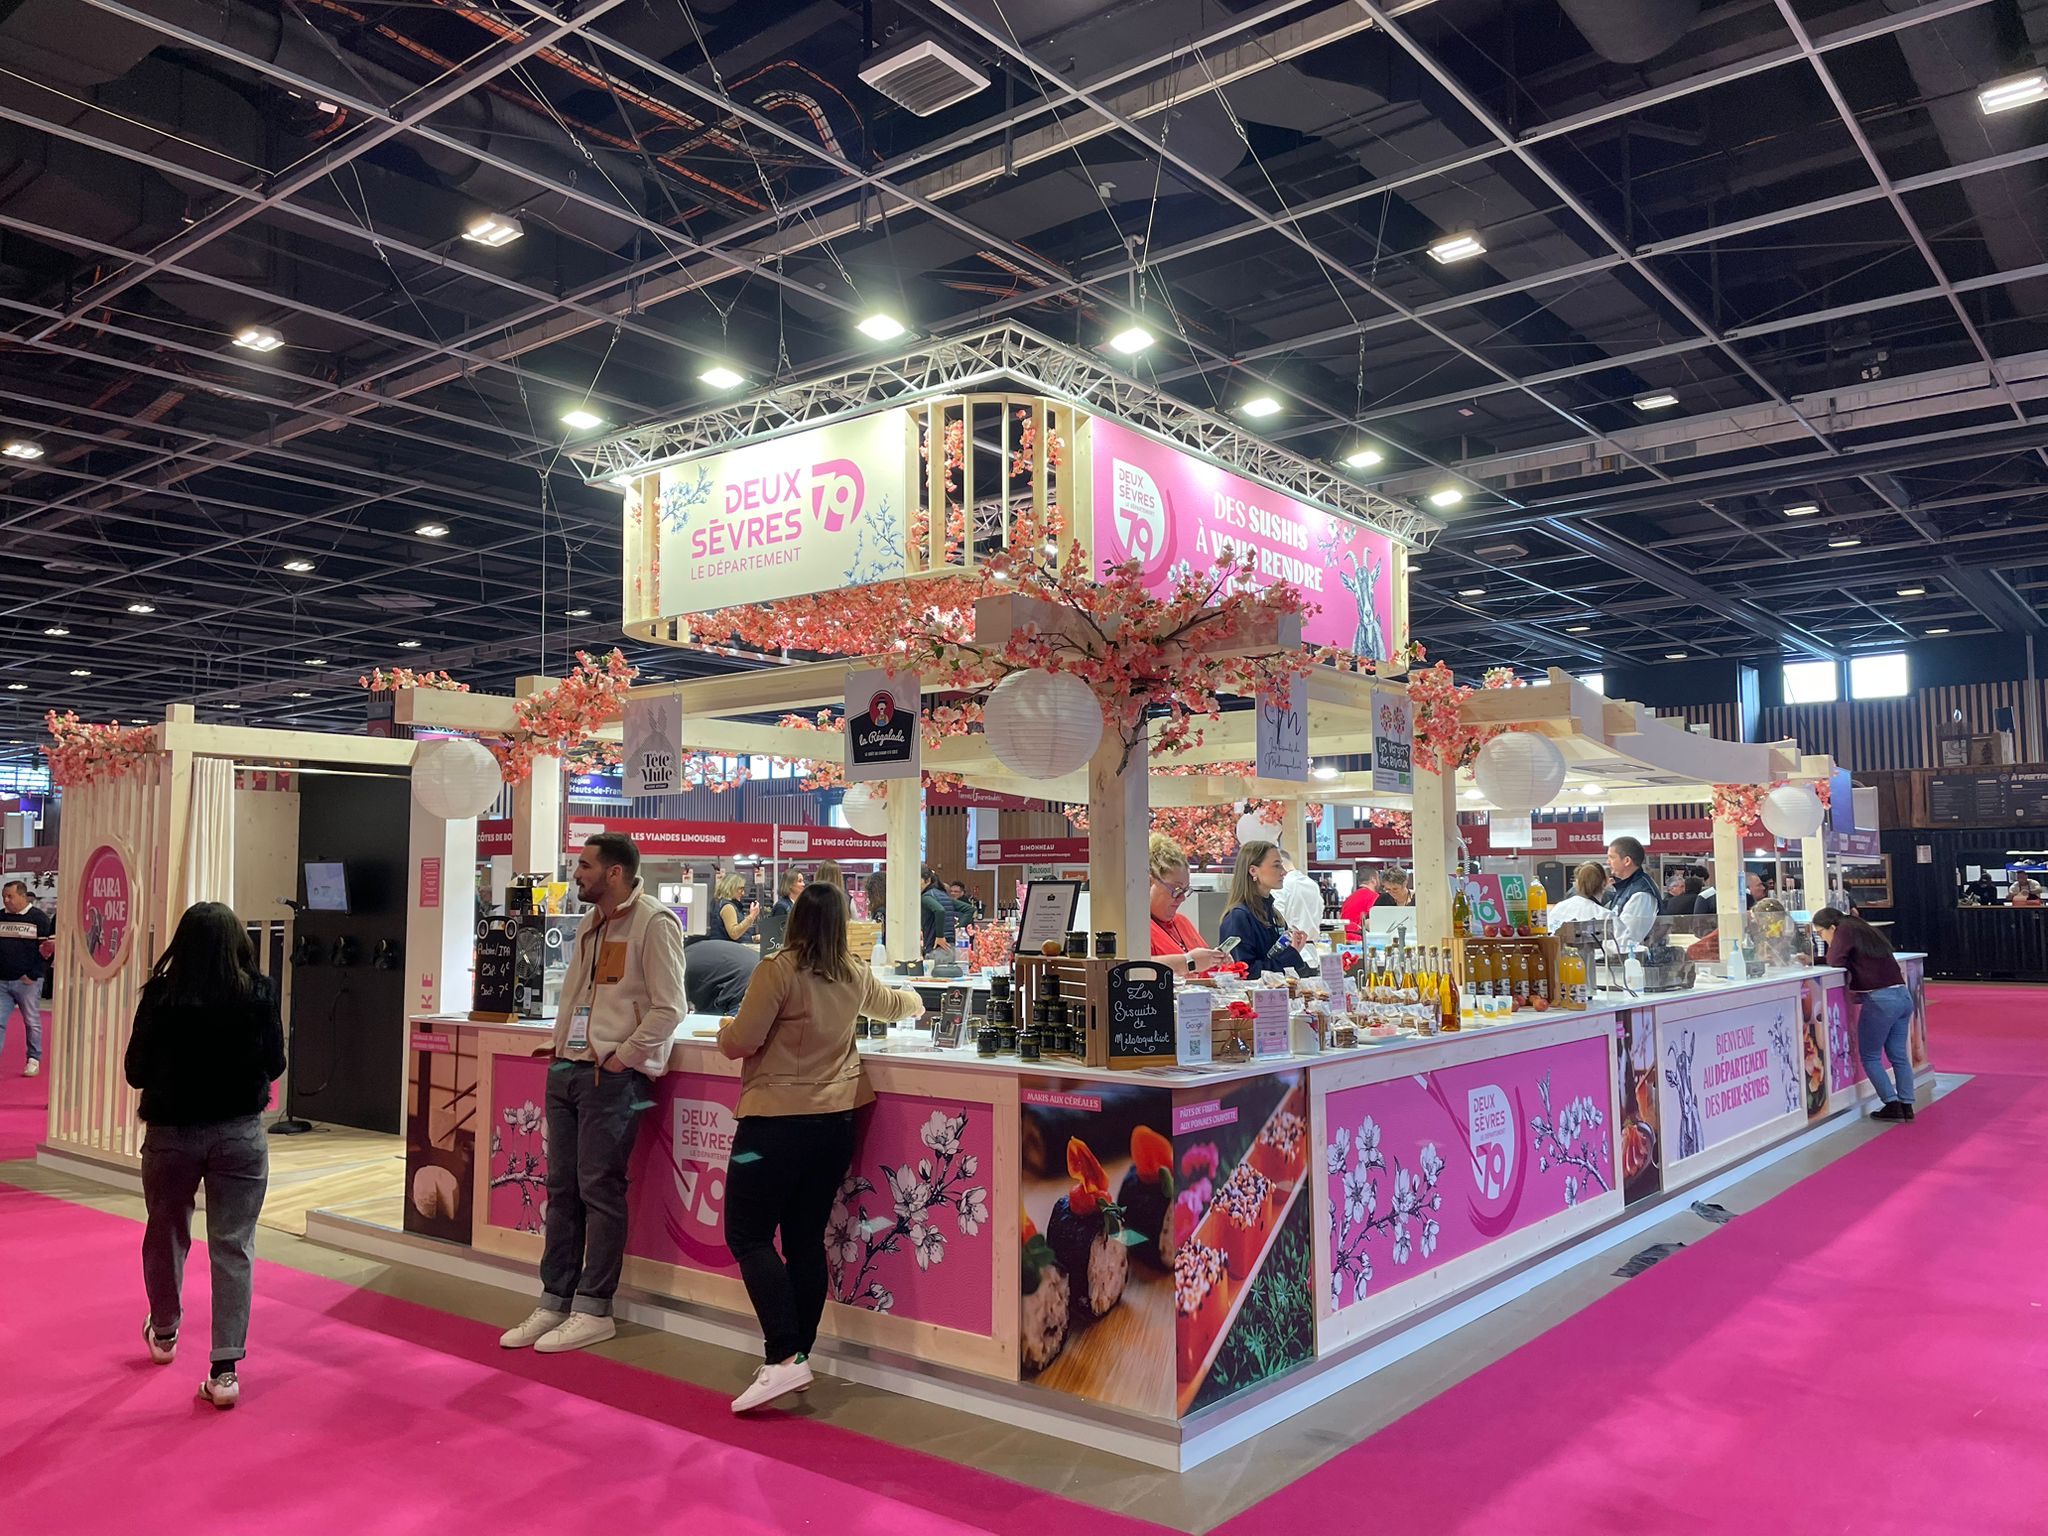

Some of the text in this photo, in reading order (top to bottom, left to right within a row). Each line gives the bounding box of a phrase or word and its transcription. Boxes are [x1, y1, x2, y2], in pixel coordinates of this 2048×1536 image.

[1118, 467, 1144, 489] DEUX
[725, 467, 802, 515] DEUX
[1214, 490, 1309, 552] DES SUSHIS
[1119, 506, 1154, 562] 79
[690, 546, 802, 581] LE DÉPARTEMENT
[1196, 517, 1209, 555] À
[1261, 546, 1324, 593] RENDRE
[868, 727, 906, 747] Régalade
[643, 753, 670, 768] Tête
[569, 776, 591, 787] Région
[569, 785, 623, 795] Hauts-de-Fran
[477, 832, 513, 842] CÔTES DE BO
[630, 832, 726, 844] LES VIANDES LIMOUSINES
[812, 837, 887, 848] LES VINS DE CÔTES DE BOUR
[1568, 834, 1604, 843] BRASSE
[1650, 831, 1714, 841] NALE DE SARLA
[93, 877, 121, 898] KARA
[1505, 884, 1523, 900] AB
[104, 901, 127, 921] OKE
[1127, 982, 1154, 1000] Les
[1114, 1000, 1157, 1022] Biscuits
[1133, 1019, 1148, 1029] de
[1715, 1025, 1756, 1056] BIENVENUE
[1703, 1048, 1769, 1090] AU DÉPARTEMENT
[1027, 1092, 1099, 1109] MAKIS AUX CÉRÉALES
[1473, 1093, 1496, 1113] DEUX
[1705, 1074, 1770, 1119] DES DEUX-SÈVRES
[681, 1108, 719, 1129] DEUX
[689, 1149, 696, 1157] LE
[1475, 1141, 1506, 1200] 79
[681, 1158, 726, 1227] 79
